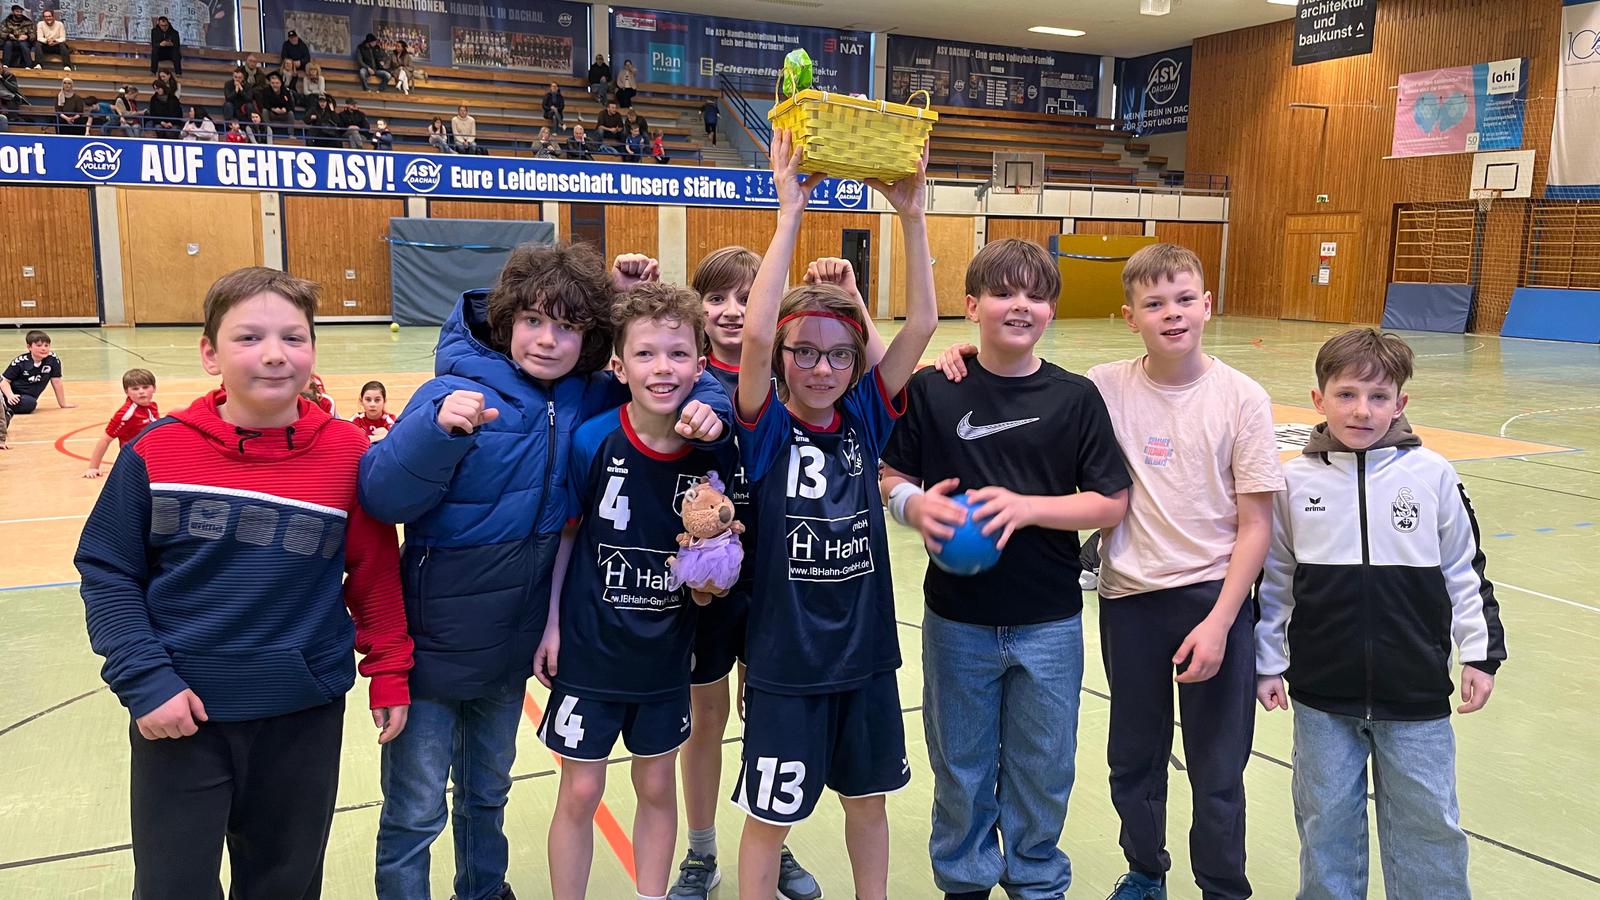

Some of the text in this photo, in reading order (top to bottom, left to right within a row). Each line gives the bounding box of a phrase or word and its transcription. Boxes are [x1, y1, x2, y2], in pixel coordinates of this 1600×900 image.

[450, 3, 495, 18] HANDBALL
[498, 8, 506, 18] IN
[1301, 0, 1364, 18] architektur
[1313, 13, 1336, 29] und
[1298, 24, 1353, 46] baukunst
[840, 43, 864, 55] NAT
[652, 52, 681, 67] Plan
[1146, 62, 1182, 93] ASV
[1151, 83, 1176, 94] DACHAU
[1157, 117, 1172, 126] UND
[0, 142, 46, 174] ort
[75, 148, 122, 168] ASV
[82, 162, 116, 171] VOLLEYS
[141, 144, 395, 191] AUF GEHTS ASV!
[403, 163, 442, 182] ASV
[409, 176, 438, 185] DACHAU
[451, 166, 740, 200] Eure Leidenschaft. Unsere Stärke.
[835, 183, 864, 198] ASV
[607, 466, 629, 474] erima
[786, 444, 827, 499] 13
[599, 475, 631, 531] 4
[792, 533, 869, 560] H Hahn
[605, 561, 673, 591] H Hah
[554, 695, 584, 749] 4
[756, 757, 806, 815] 13
